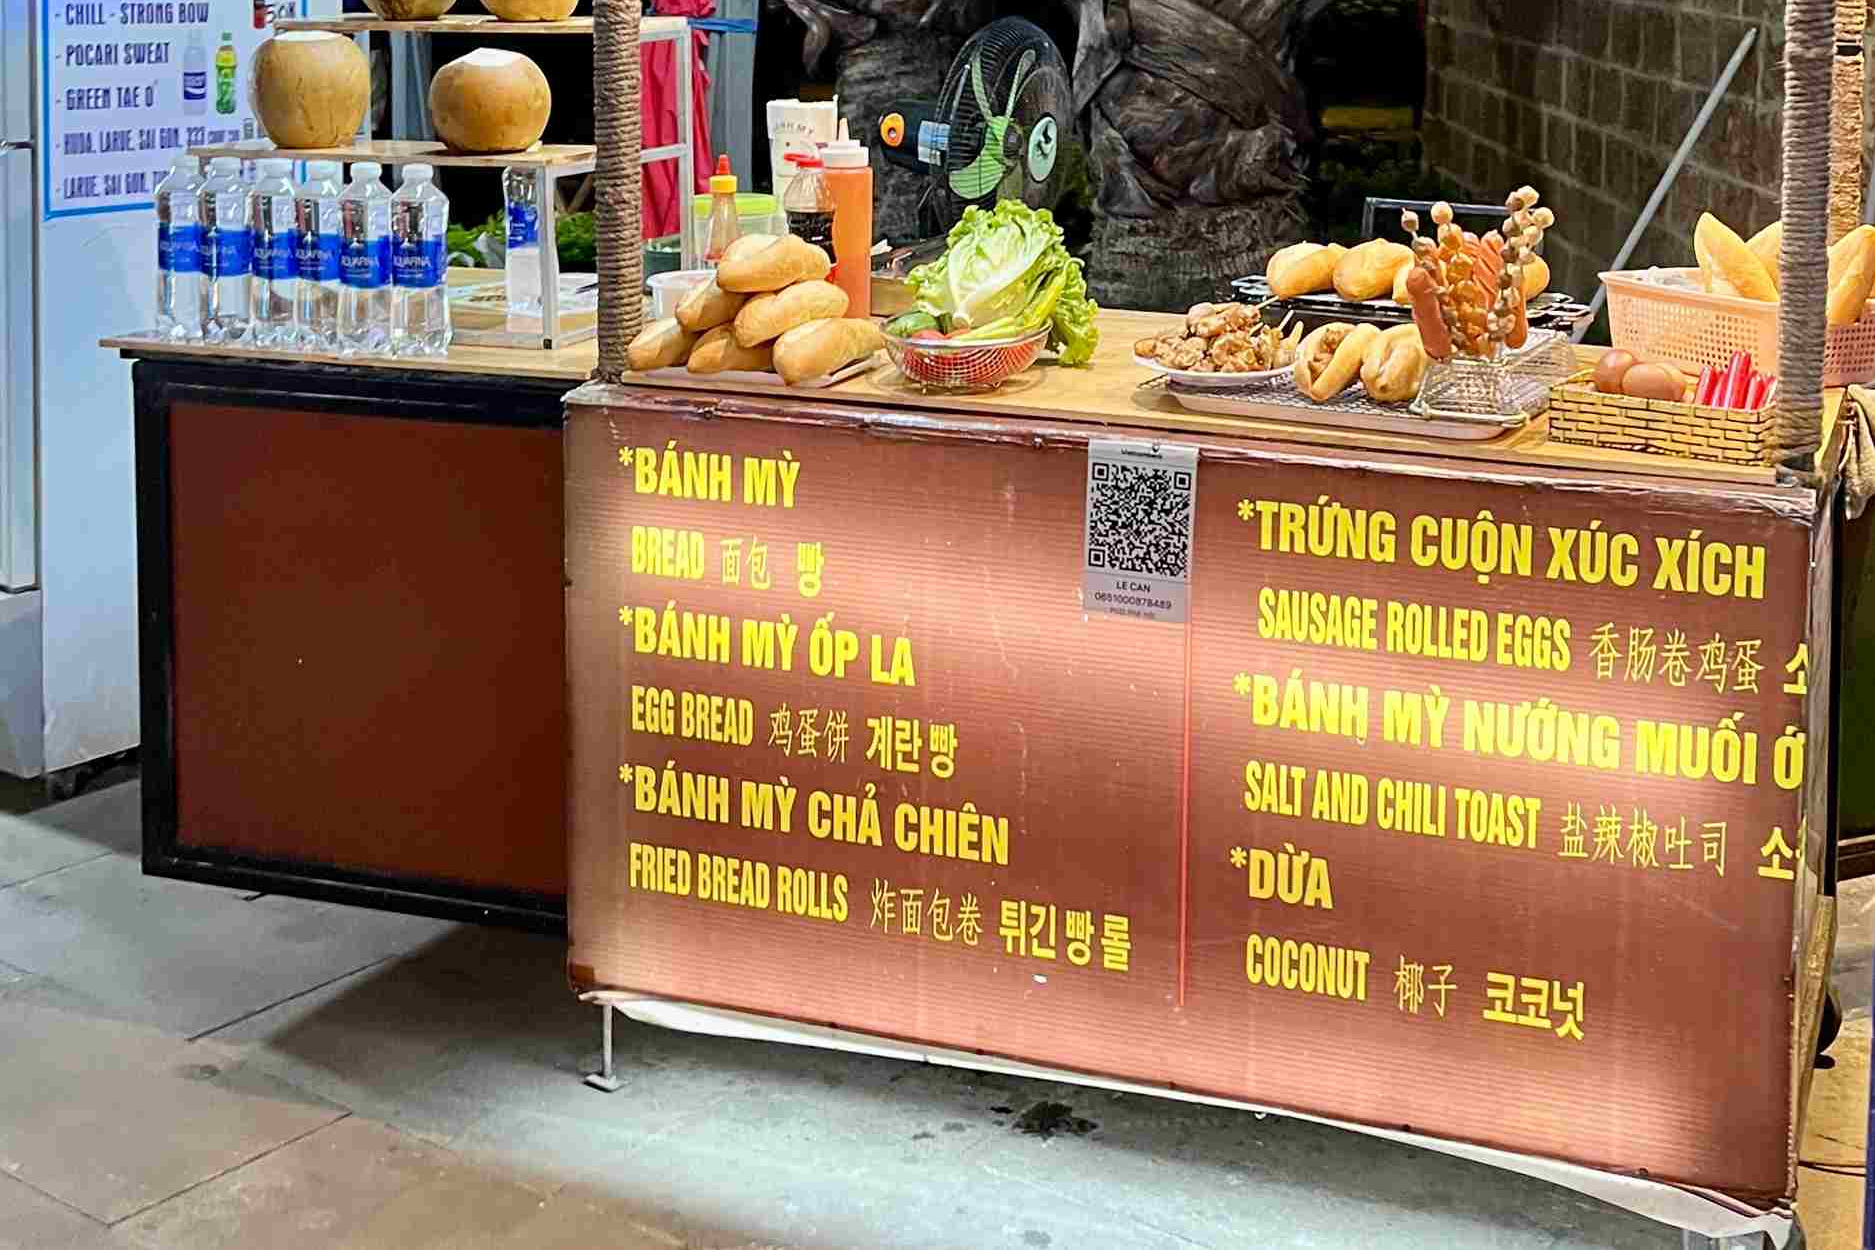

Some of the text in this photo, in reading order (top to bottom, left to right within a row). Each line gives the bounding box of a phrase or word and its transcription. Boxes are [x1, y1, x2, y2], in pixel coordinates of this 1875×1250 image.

[65, 3, 106, 25] CHILL
[120, 3, 174, 25] STRONG
[178, 3, 209, 23] BOW
[65, 42, 170, 67] POCARI SWEAT
[66, 87, 111, 110] GREEN
[744, 450, 800, 507] MỲ
[631, 525, 704, 580] BREAD
[720, 535, 772, 590] 面包
[796, 542, 825, 597] 빵
[1411, 510, 1533, 584] CUỘN
[1546, 520, 1639, 587] XÚC
[1653, 530, 1766, 599] XÍCH
[1116, 581, 1151, 593] LE CAN
[742, 614, 798, 671] MỲ
[809, 611, 859, 678] ỐP
[1258, 587, 1571, 672] SAUSAGE ROLLED EGGS
[1589, 622, 1765, 694] 香肠卷鸡蛋
[631, 685, 753, 746] EGG BREAD
[768, 702, 849, 763] 鸡蛋饼
[1384, 685, 1450, 748] MỲ
[1464, 696, 1620, 770] NƯỚNG
[1635, 712, 1758, 784] MUỐI
[865, 716, 958, 778] 계란 빵
[741, 776, 797, 833] MỲ
[808, 783, 883, 847] CHẢ
[895, 802, 1009, 865] CHIÊN
[1245, 760, 1541, 848] SALT AND CHILI TOAST
[1557, 802, 1728, 877] 盐辣椒吐司
[1758, 827, 1806, 880] 소
[630, 843, 848, 922] FRIED BREAD ROLLS
[870, 878, 983, 946] 炸面包卷
[1000, 900, 1056, 959] 튀긴
[1246, 934, 1371, 1001] COCONUT
[1393, 955, 1457, 1017] 椰子
[1483, 972, 1584, 1040] 코코넛
